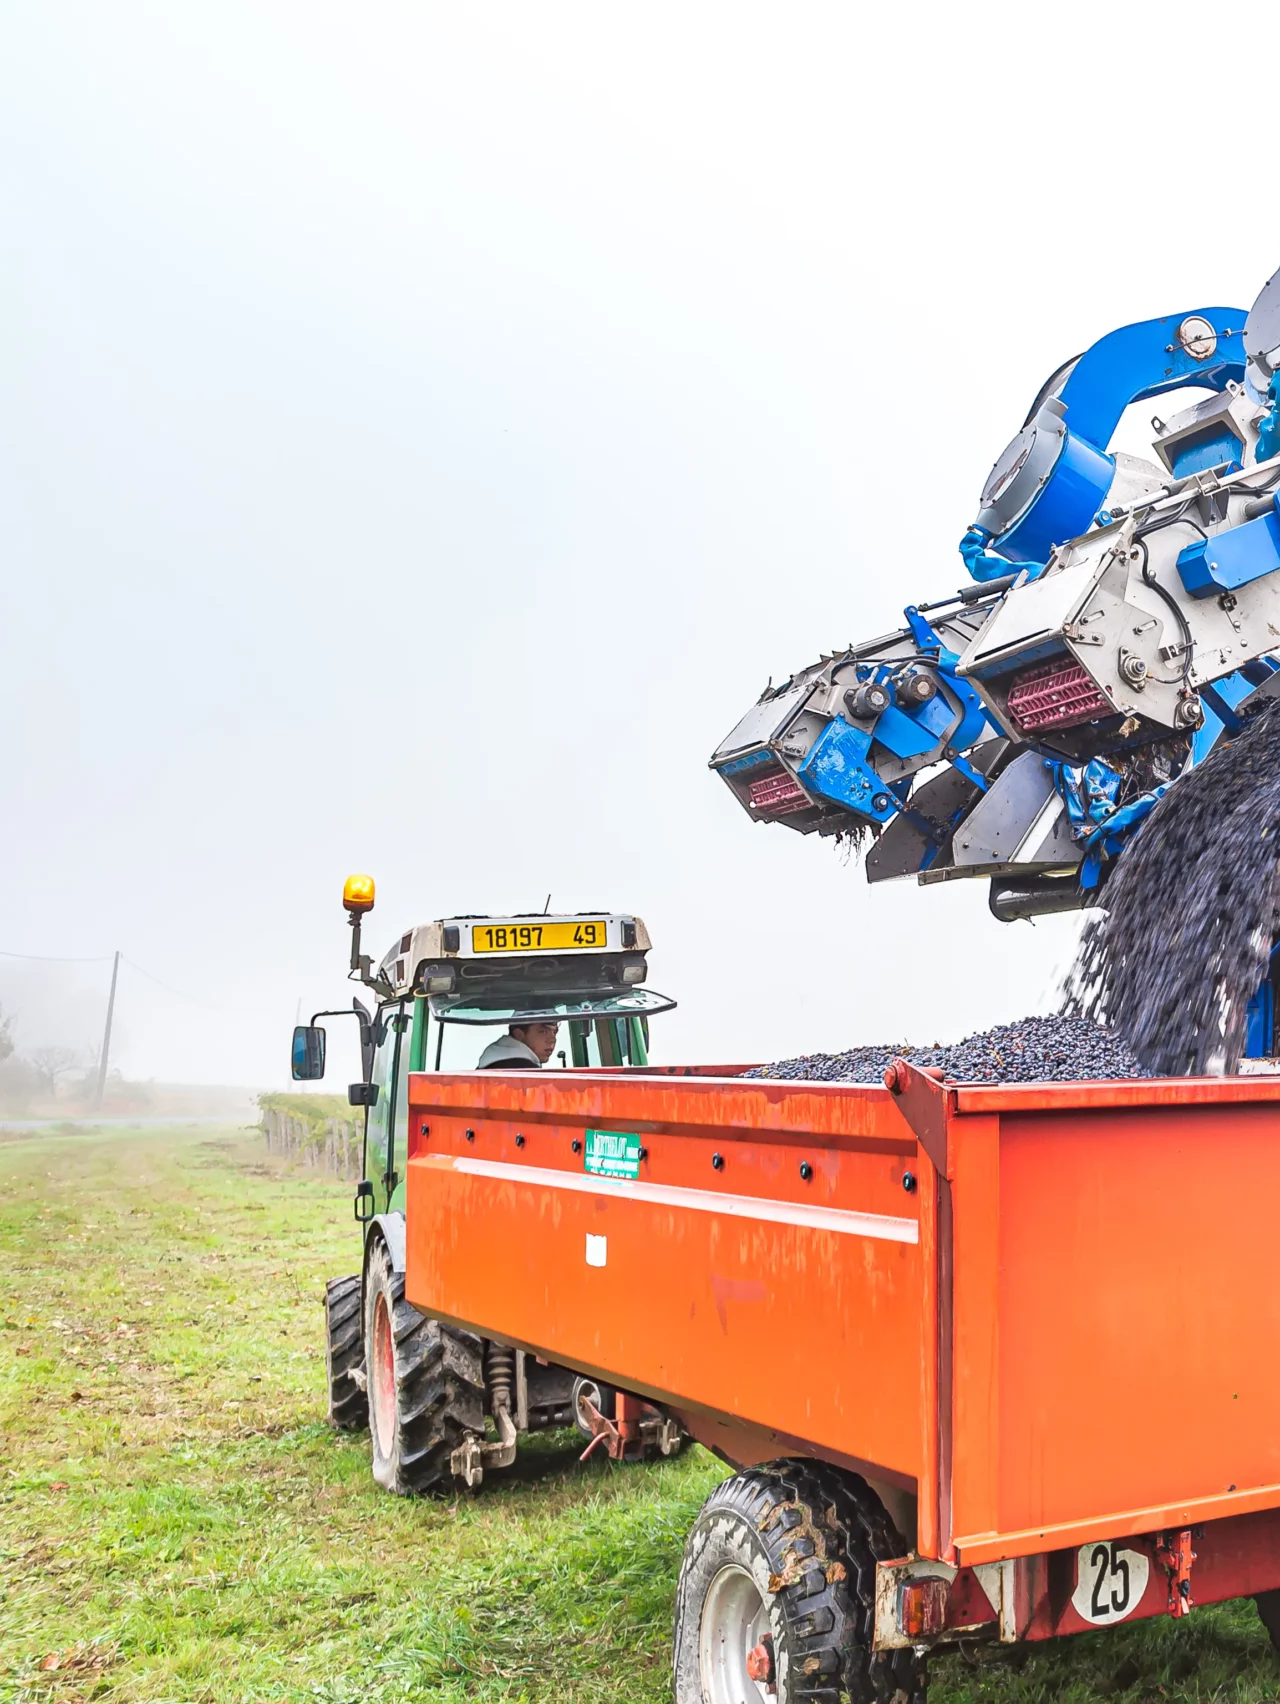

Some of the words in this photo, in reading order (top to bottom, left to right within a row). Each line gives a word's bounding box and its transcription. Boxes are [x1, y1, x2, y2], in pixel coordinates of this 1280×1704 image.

[485, 927, 543, 948] 18197
[573, 924, 596, 945] 49
[1090, 1542, 1130, 1617] 25
